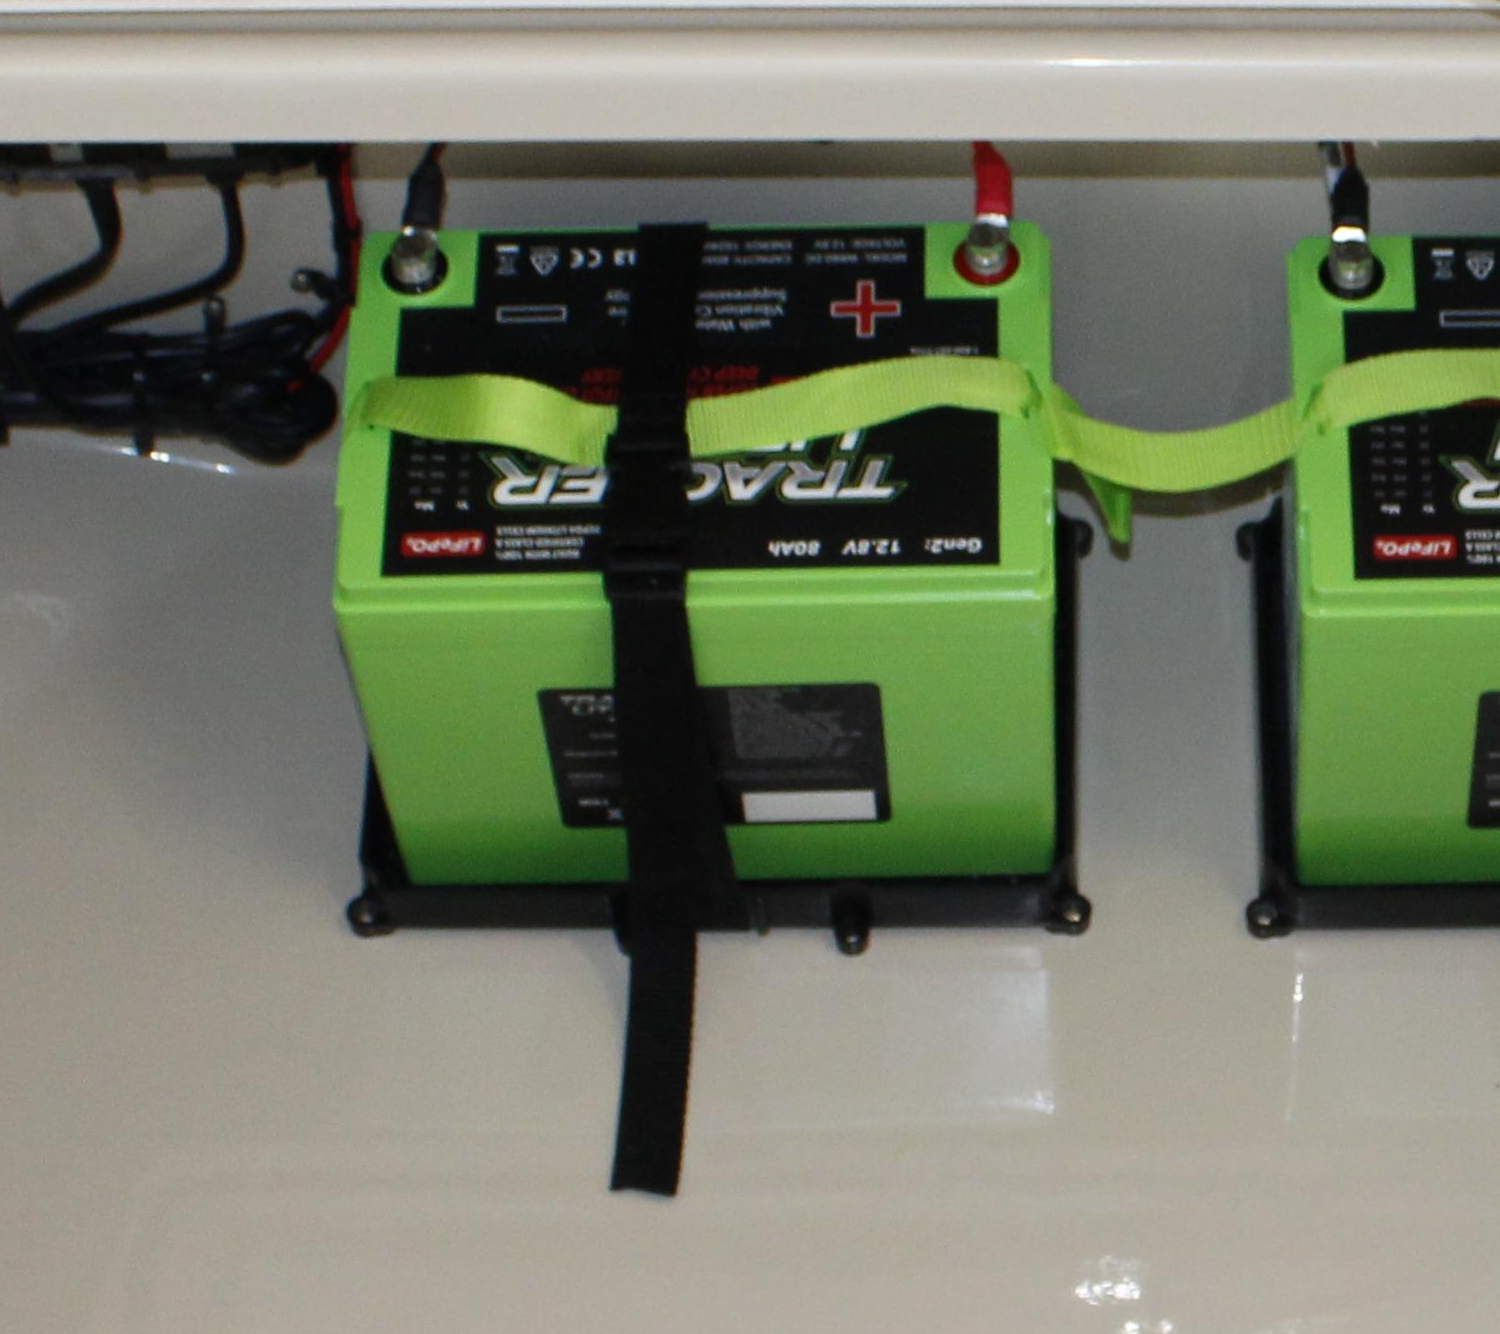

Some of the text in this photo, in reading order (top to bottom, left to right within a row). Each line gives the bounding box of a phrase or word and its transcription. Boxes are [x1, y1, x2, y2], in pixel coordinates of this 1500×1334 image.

[488, 455, 898, 505] TRACER
[768, 538, 822, 557] 80Ah
[841, 538, 901, 556] 12.8V
